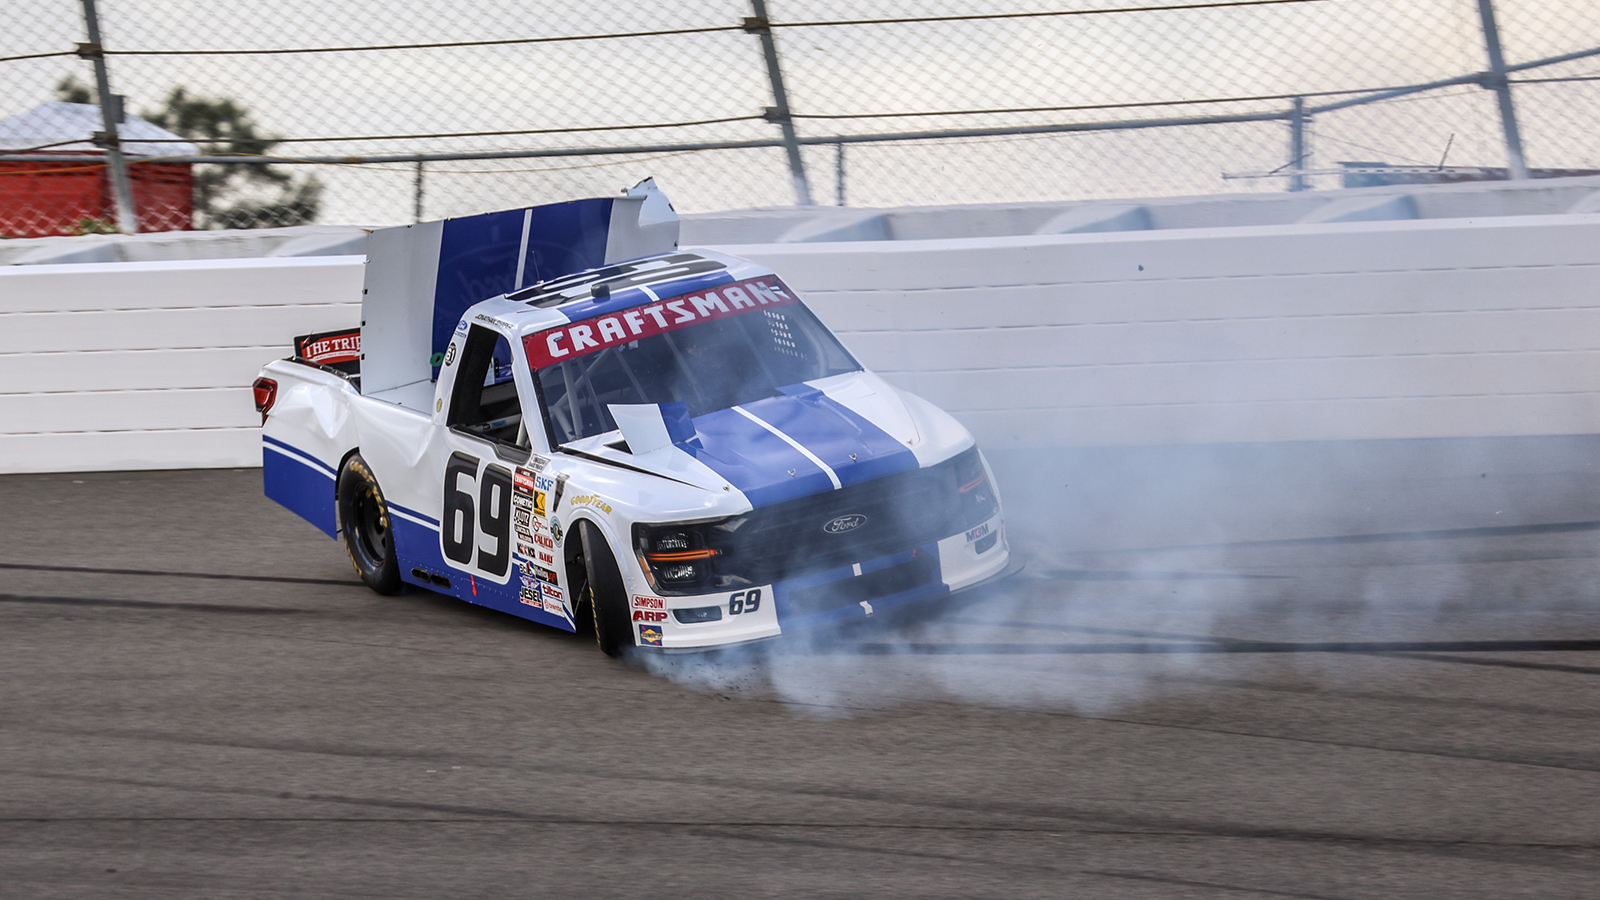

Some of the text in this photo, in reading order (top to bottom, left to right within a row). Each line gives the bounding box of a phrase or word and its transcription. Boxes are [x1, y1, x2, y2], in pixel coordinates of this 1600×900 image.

[546, 281, 780, 358] CRAFTSMAN
[305, 340, 331, 358] THE
[535, 476, 554, 491] SKF
[513, 494, 533, 509] COMETIC
[571, 494, 613, 515] GOODYEAR
[442, 450, 513, 577] 69
[831, 517, 860, 532] Ford
[534, 534, 553, 548] CALICO
[519, 588, 541, 602] JESEL
[542, 584, 563, 599] tilton
[634, 596, 664, 609] SIMPSON
[729, 589, 761, 615] 69
[632, 610, 668, 622] ARP
